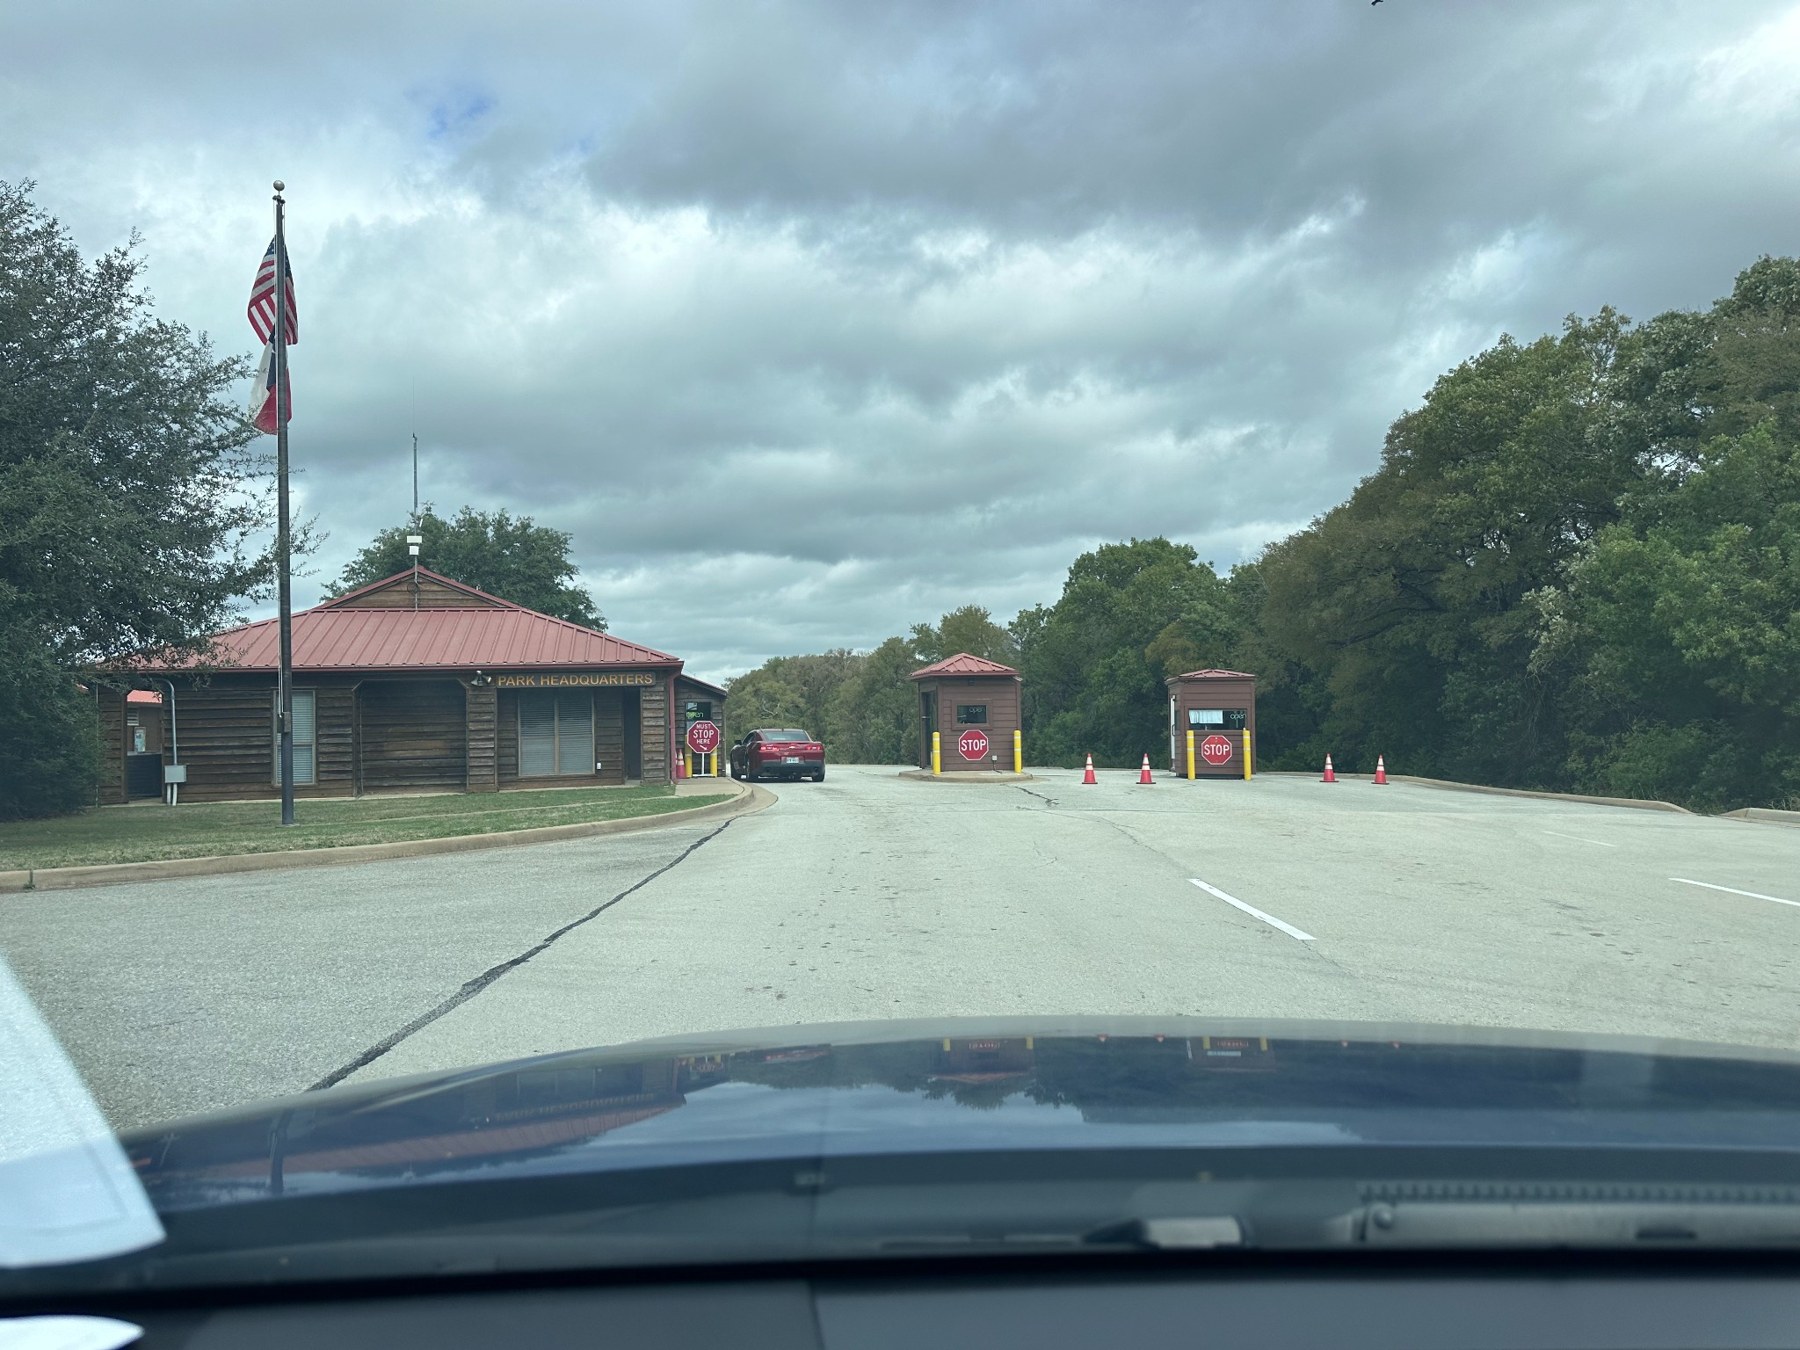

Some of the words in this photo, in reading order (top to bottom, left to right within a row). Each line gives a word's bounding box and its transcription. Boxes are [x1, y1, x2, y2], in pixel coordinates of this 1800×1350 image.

[498, 675, 535, 686] PARK
[540, 674, 653, 685] HEADQUARTERS
[693, 729, 714, 739] STOP
[961, 739, 987, 751] STOP
[1203, 744, 1230, 756] STOP
